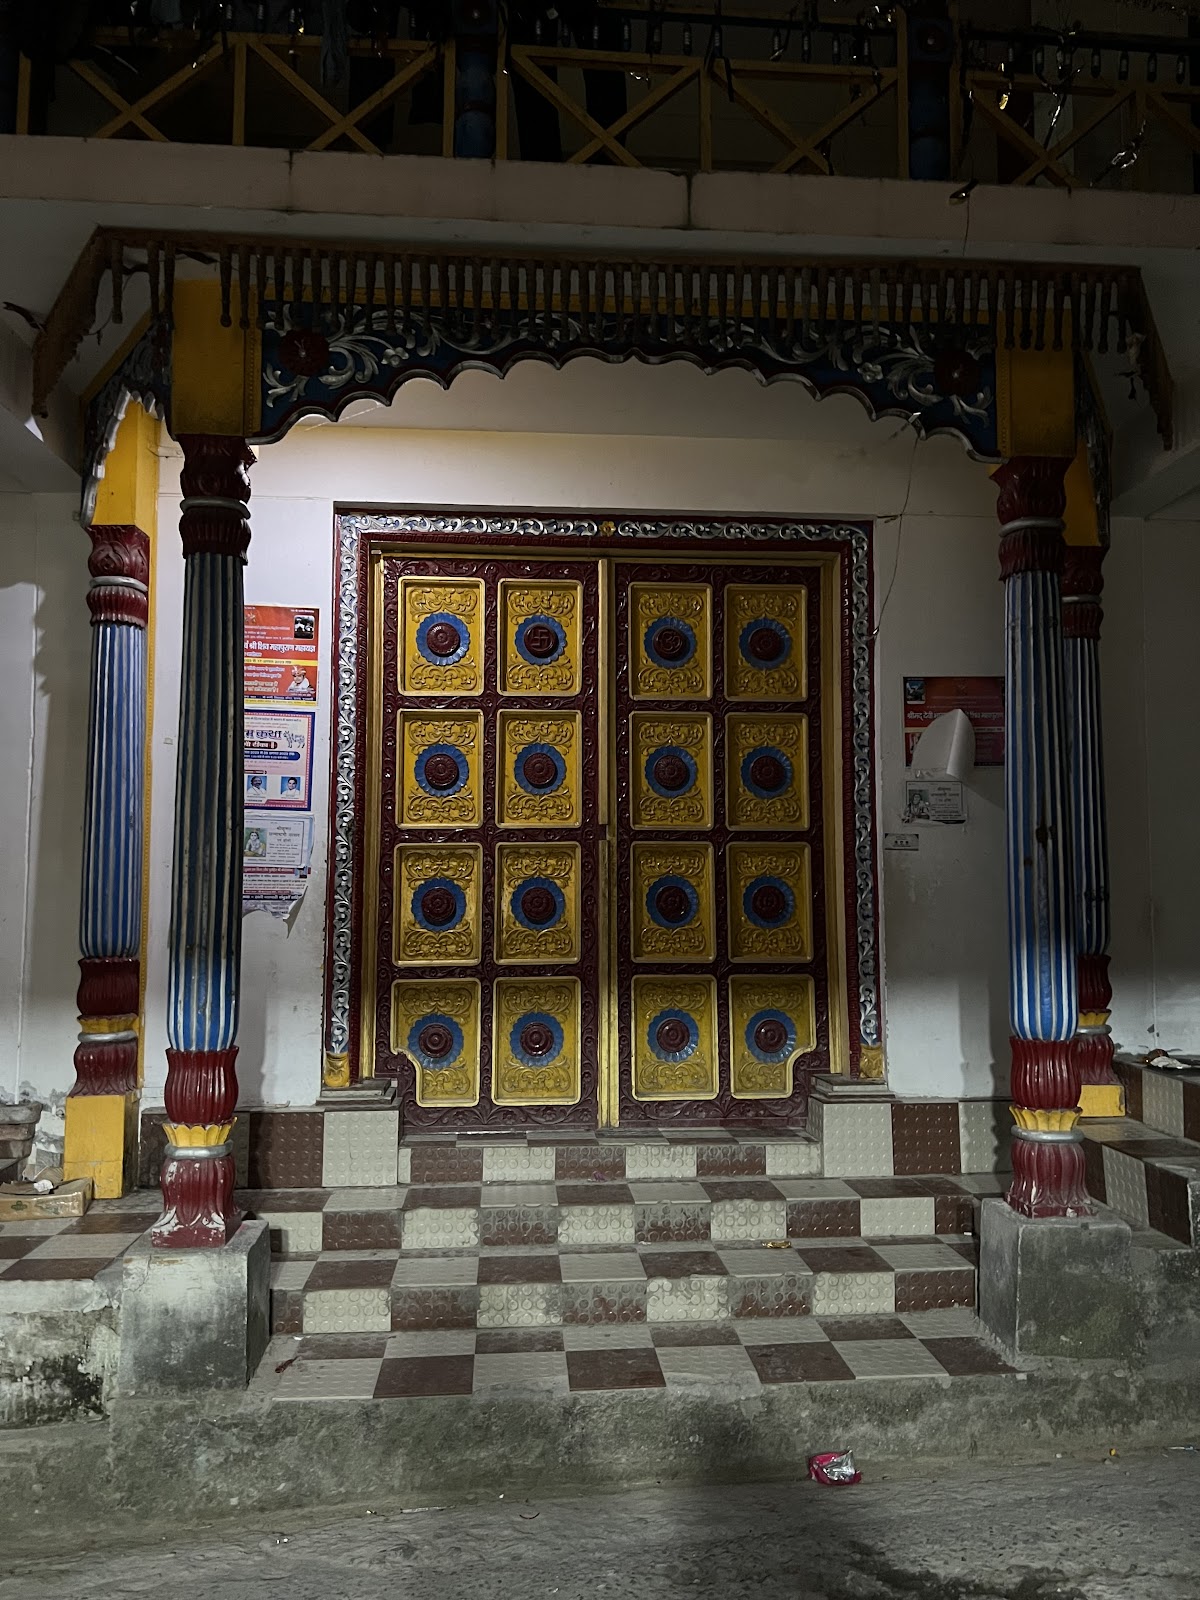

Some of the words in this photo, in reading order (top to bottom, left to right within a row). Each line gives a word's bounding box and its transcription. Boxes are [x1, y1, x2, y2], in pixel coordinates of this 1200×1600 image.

[249, 640, 257, 650] श्री
[257, 641, 269, 650] शिव
[269, 643, 295, 653] महापुराण
[256, 729, 282, 740] कथा
